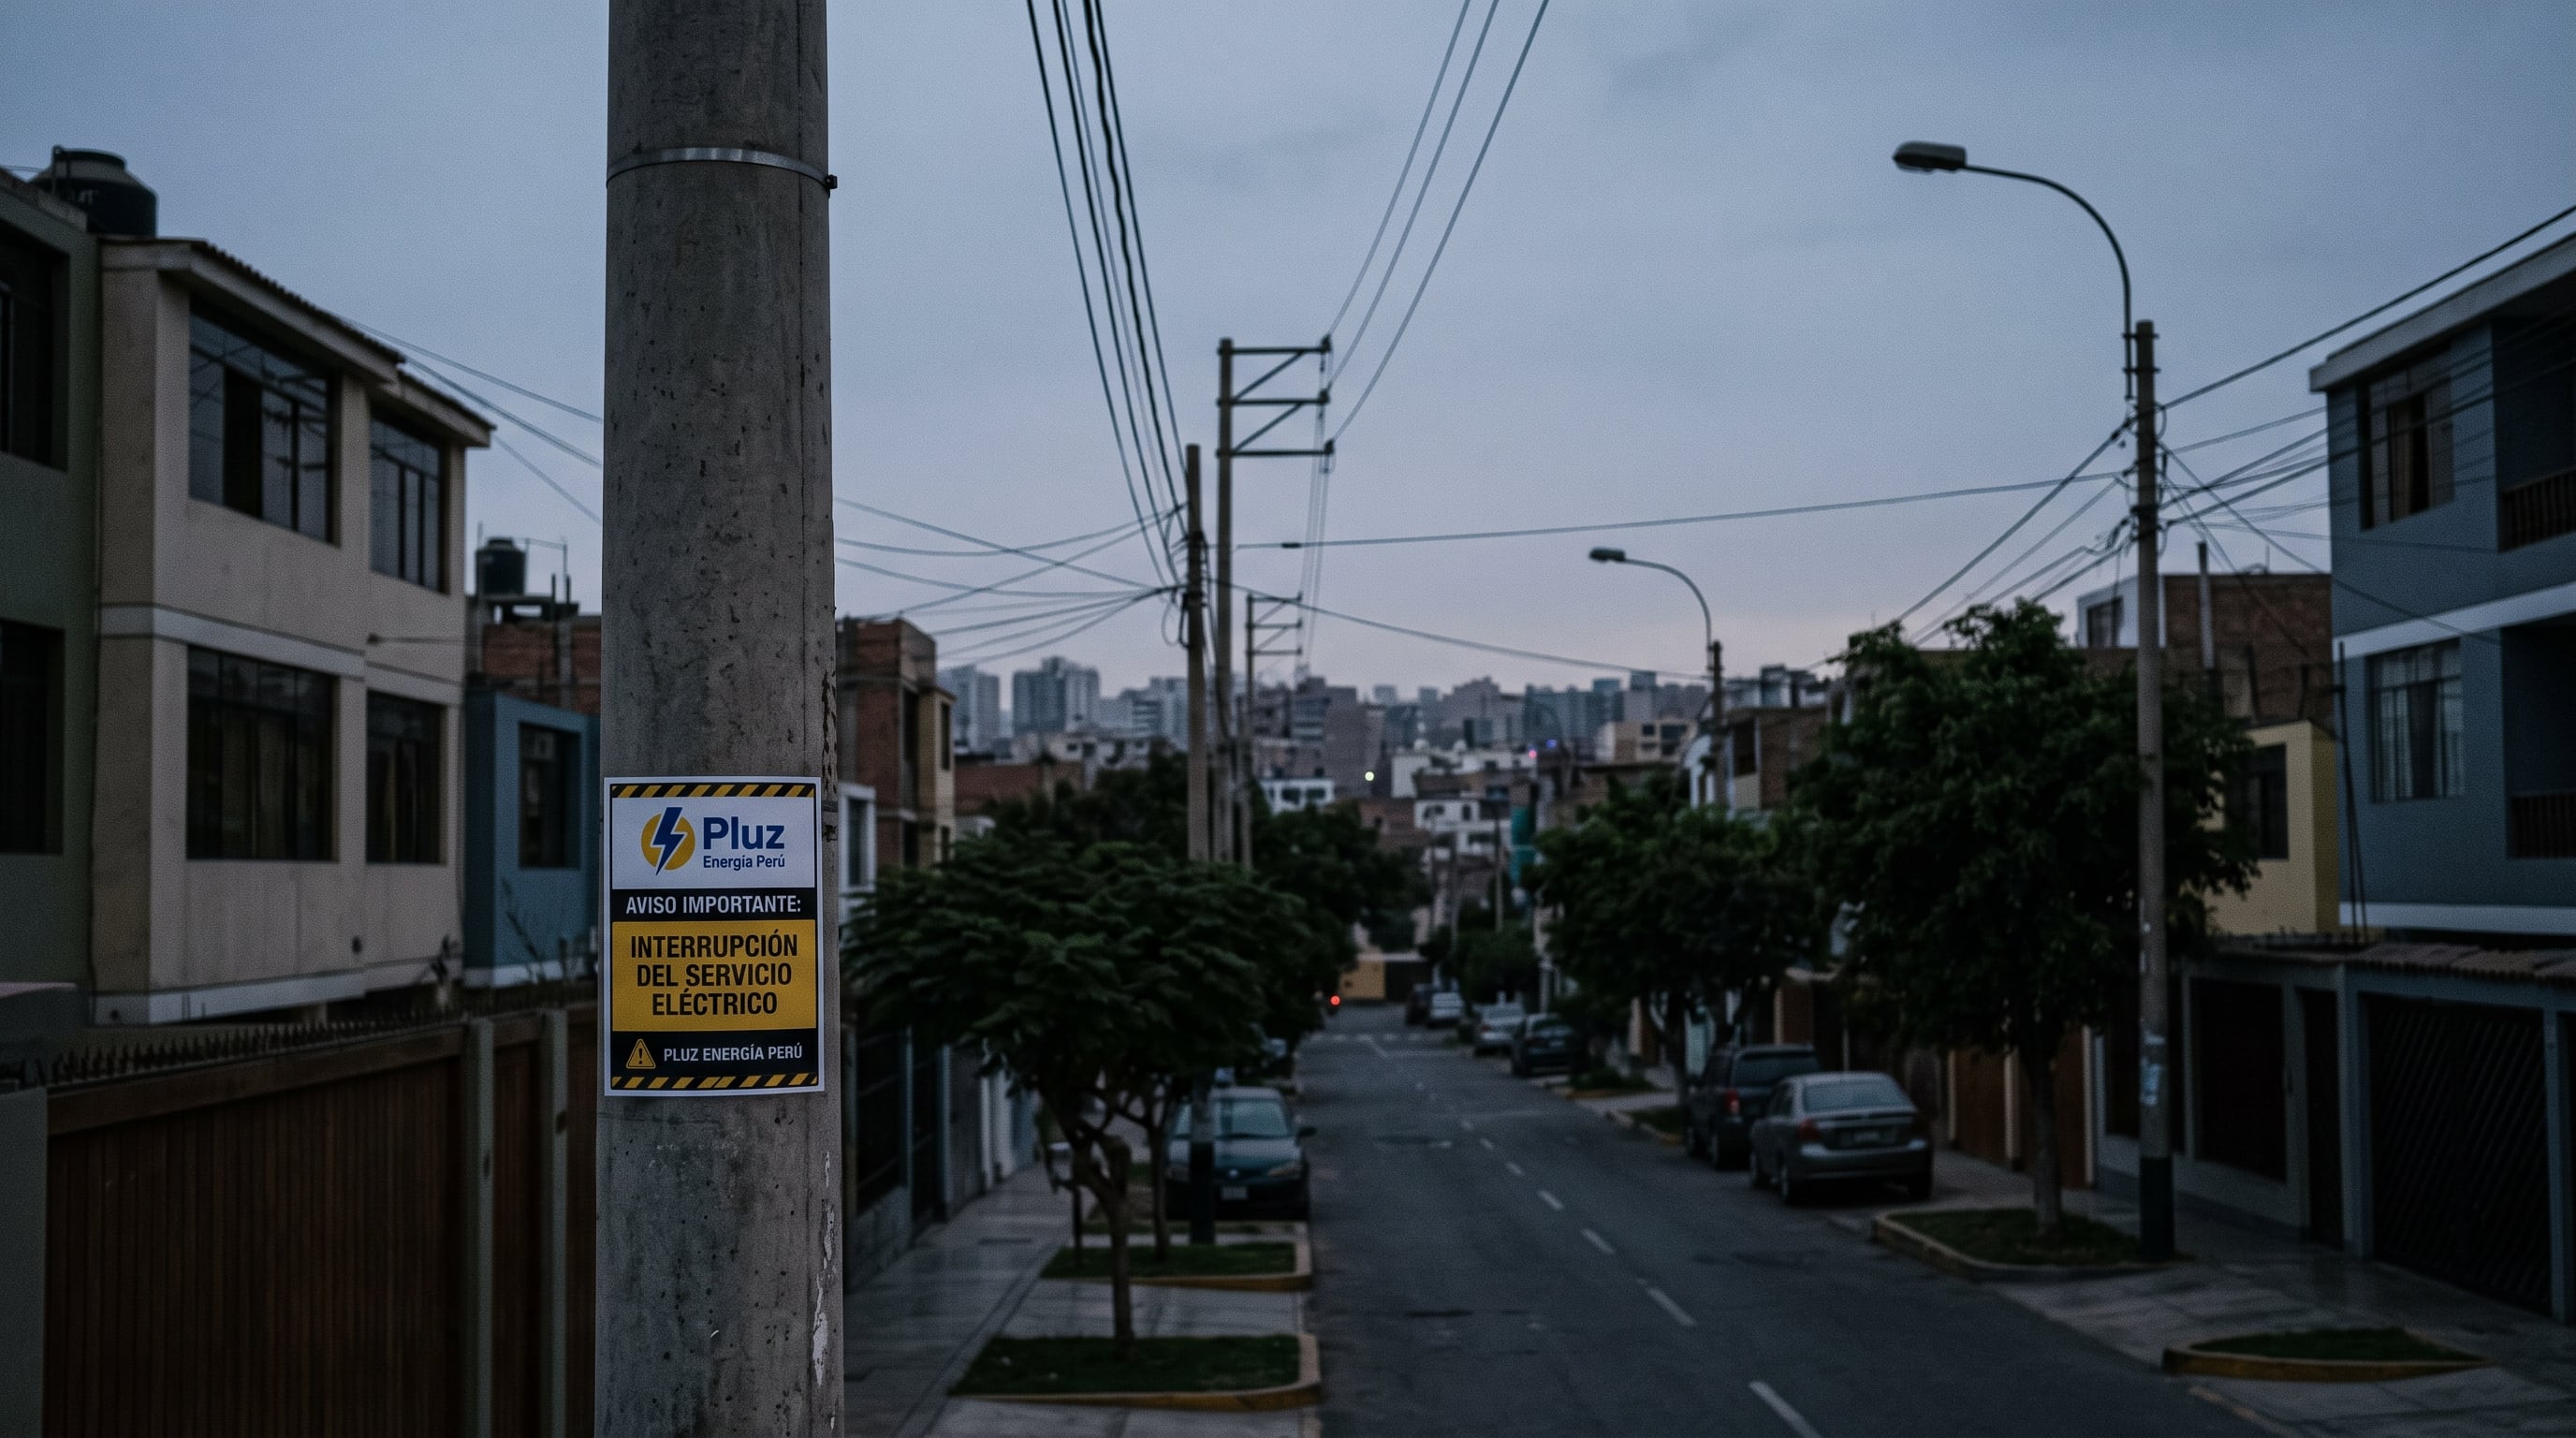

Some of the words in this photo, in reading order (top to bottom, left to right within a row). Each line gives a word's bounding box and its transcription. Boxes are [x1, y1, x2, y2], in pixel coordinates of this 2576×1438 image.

[703, 816, 784, 850] Pluz
[756, 853, 785, 868] Perú
[626, 896, 677, 915] AVISO
[683, 895, 801, 914] IMPORTANTE:
[631, 929, 798, 959] INTERRUPCIÓN
[637, 964, 679, 987] DEL
[685, 962, 792, 986] SERVICIO
[652, 988, 777, 1016] ELÉCTRICO
[664, 1048, 699, 1062] PLUZ
[703, 1043, 764, 1062] ENERGÍA
[768, 1044, 802, 1060] PERÚ
